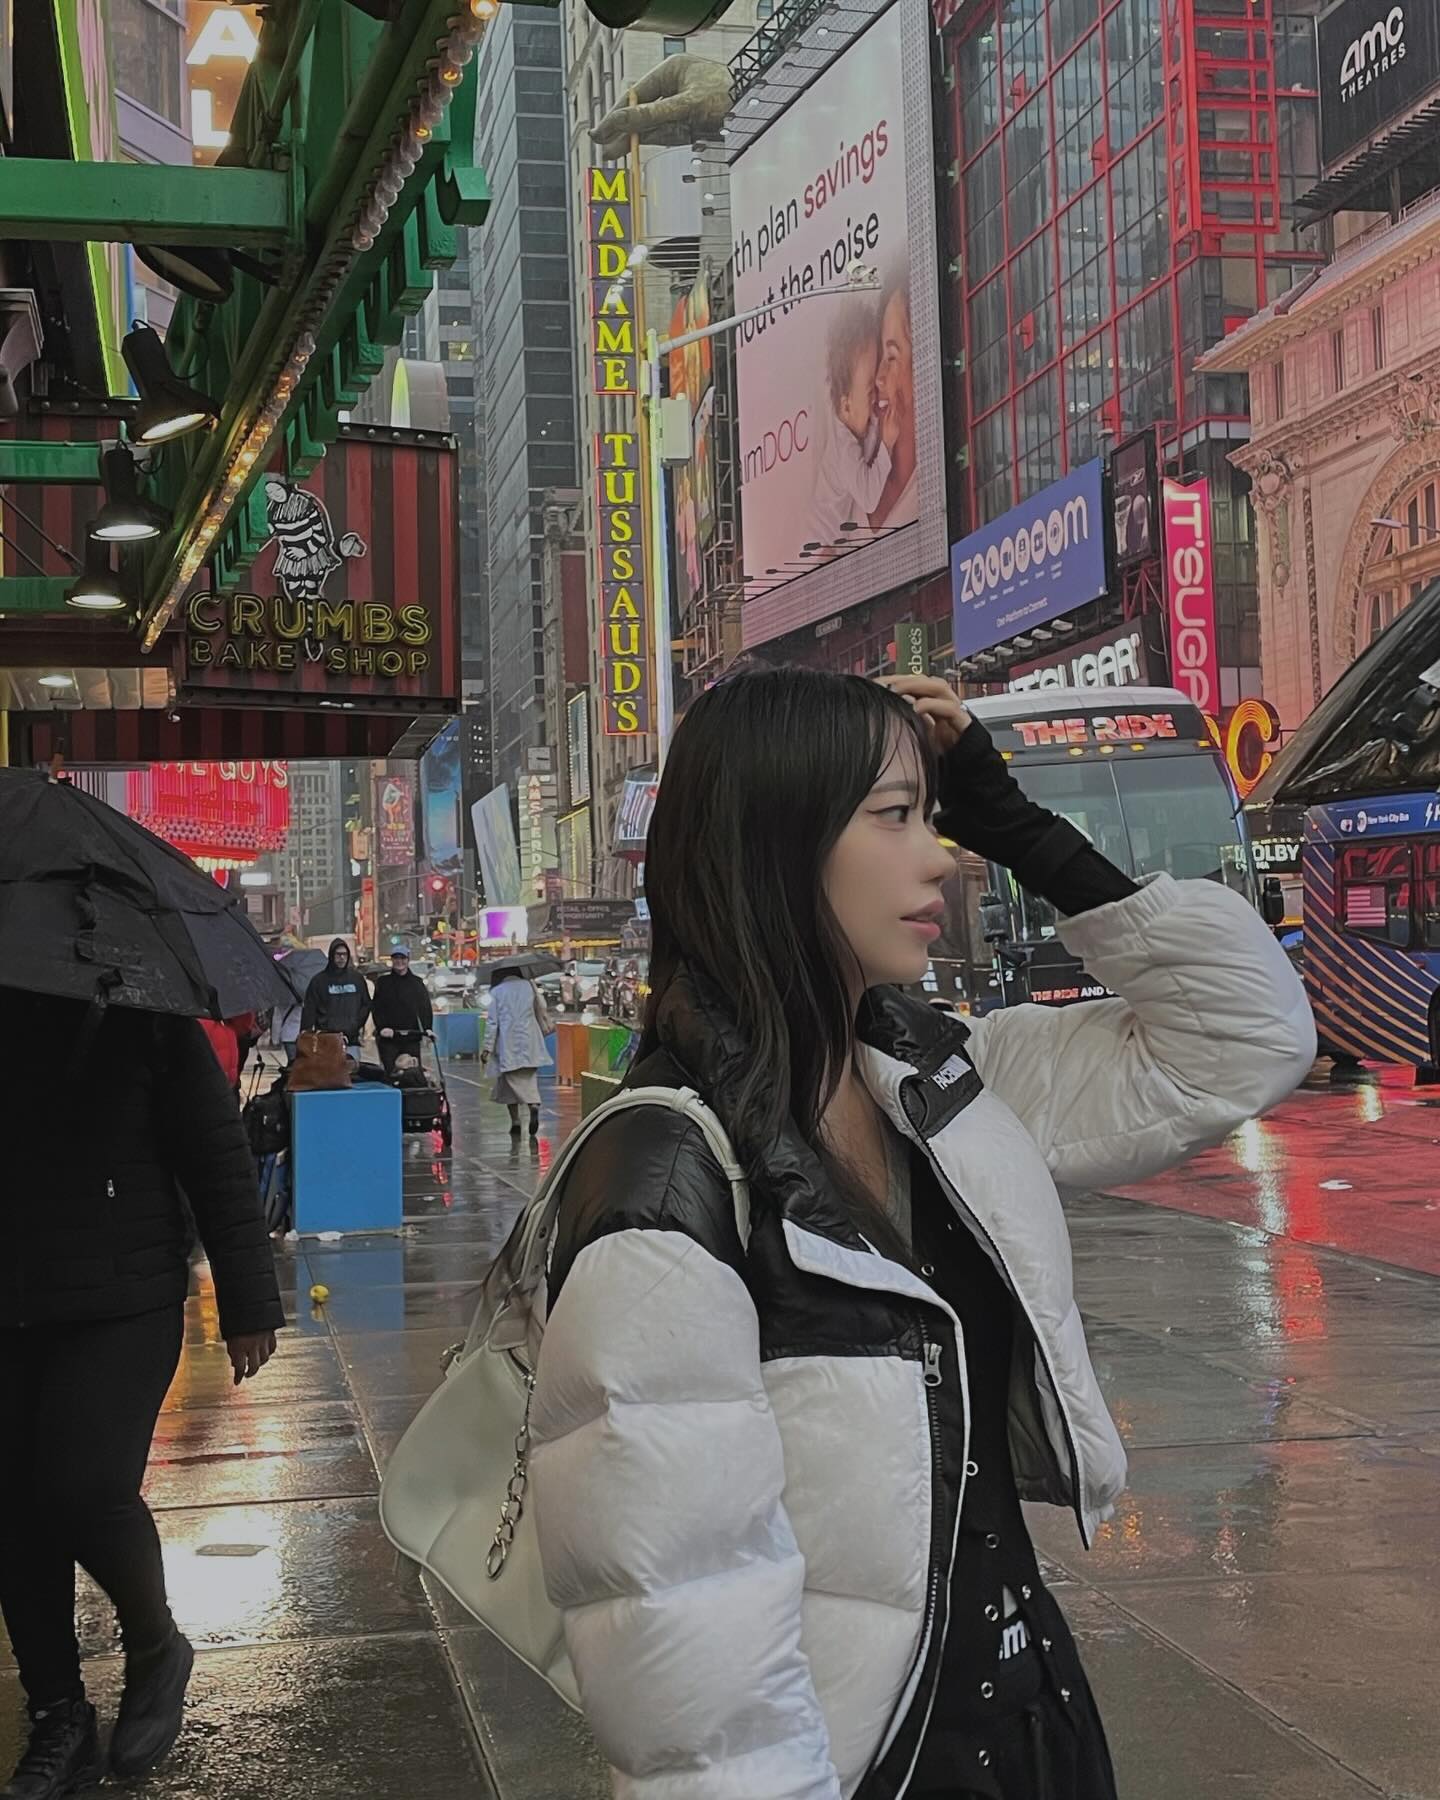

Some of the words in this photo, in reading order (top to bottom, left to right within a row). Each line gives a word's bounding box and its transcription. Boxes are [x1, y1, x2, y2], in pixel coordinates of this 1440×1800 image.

[1341, 42, 1406, 103] THEATRES
[758, 199, 798, 272] plan
[804, 120, 888, 218] savings
[592, 169, 634, 391] MADAME
[780, 265, 814, 314] the
[820, 213, 879, 286] noise
[189, 592, 432, 646] CRUMBS
[603, 433, 642, 732] TUSSAUD'S
[1168, 490, 1212, 714] IT'SUGA
[190, 640, 298, 672] BAKE
[325, 645, 430, 678] SHOP
[1012, 718, 1089, 747] THE
[1093, 713, 1178, 742] RIDE
[1030, 990, 1052, 1002] THE
[1052, 988, 1080, 1000] RIDE
[1080, 985, 1104, 998] AND
